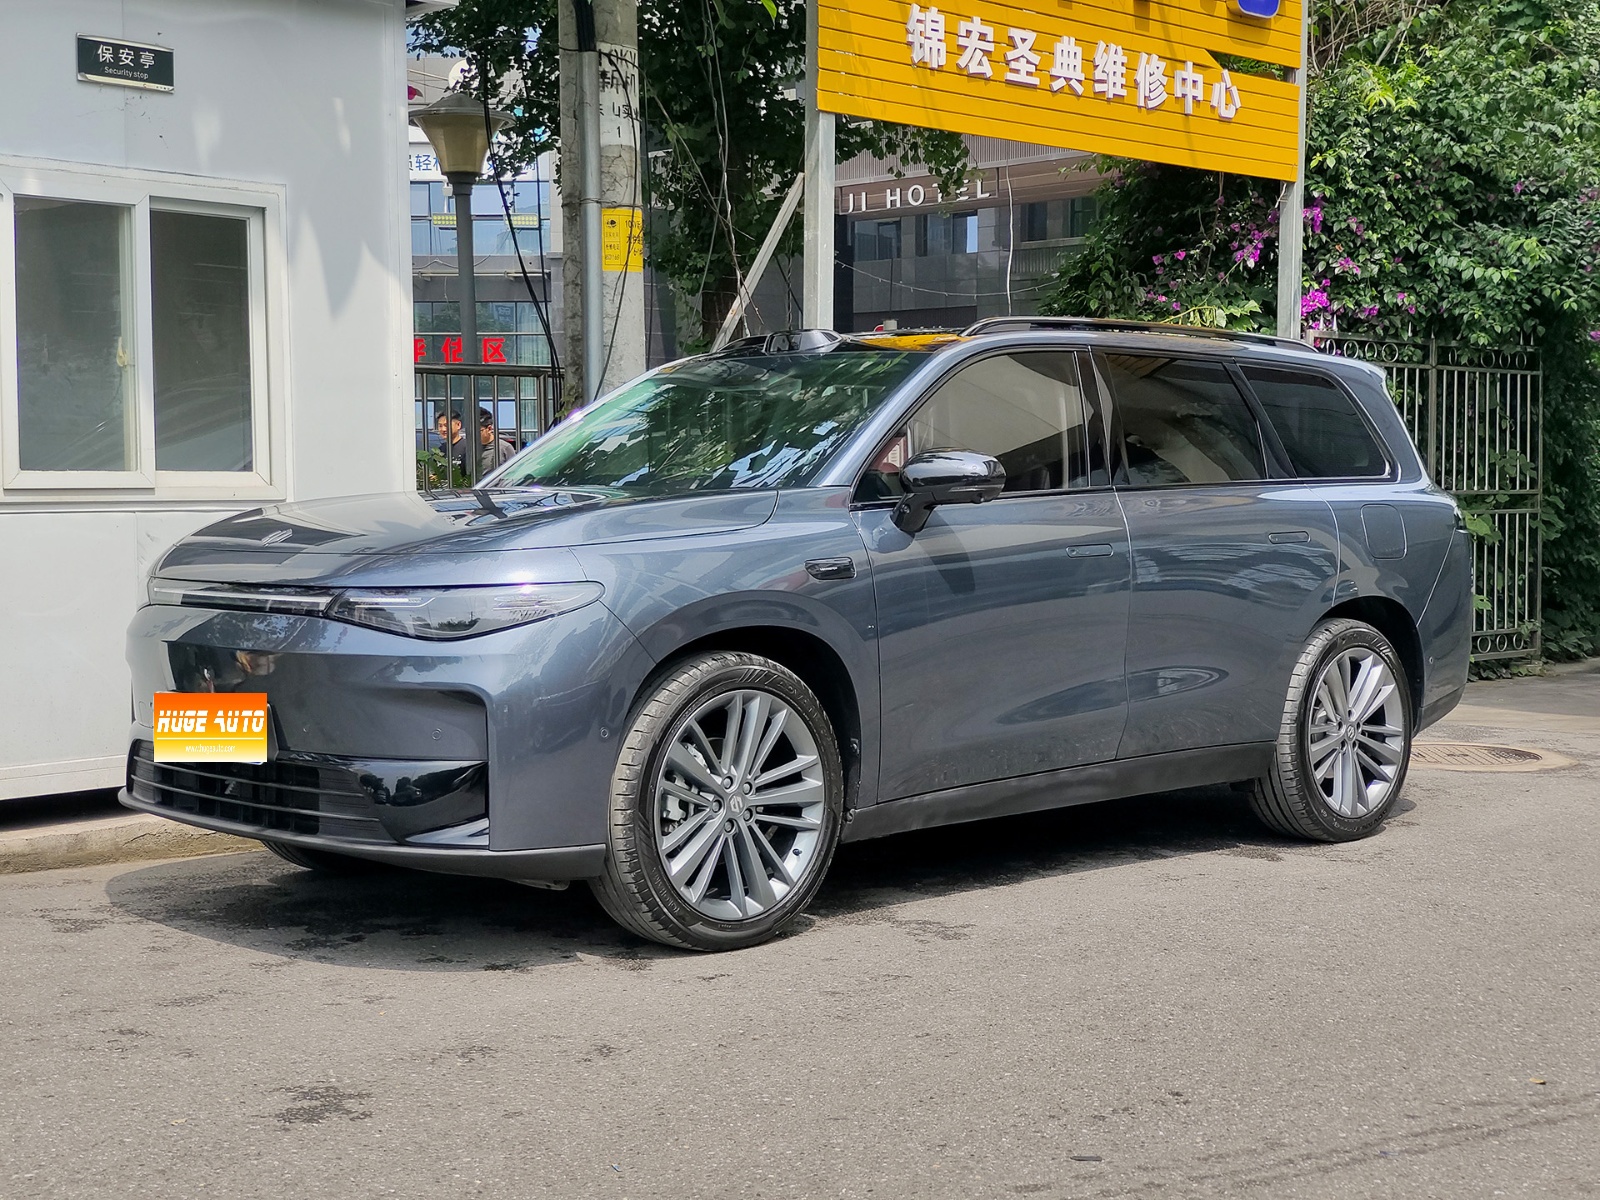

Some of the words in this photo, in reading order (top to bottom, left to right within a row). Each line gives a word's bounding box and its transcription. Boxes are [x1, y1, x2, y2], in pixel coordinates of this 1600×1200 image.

[97, 44, 155, 69] 保安亭
[906, 3, 1242, 120] 锦宏圣典维修中心
[104, 66, 132, 78] Security
[133, 71, 149, 80] stop
[848, 191, 867, 213] JI
